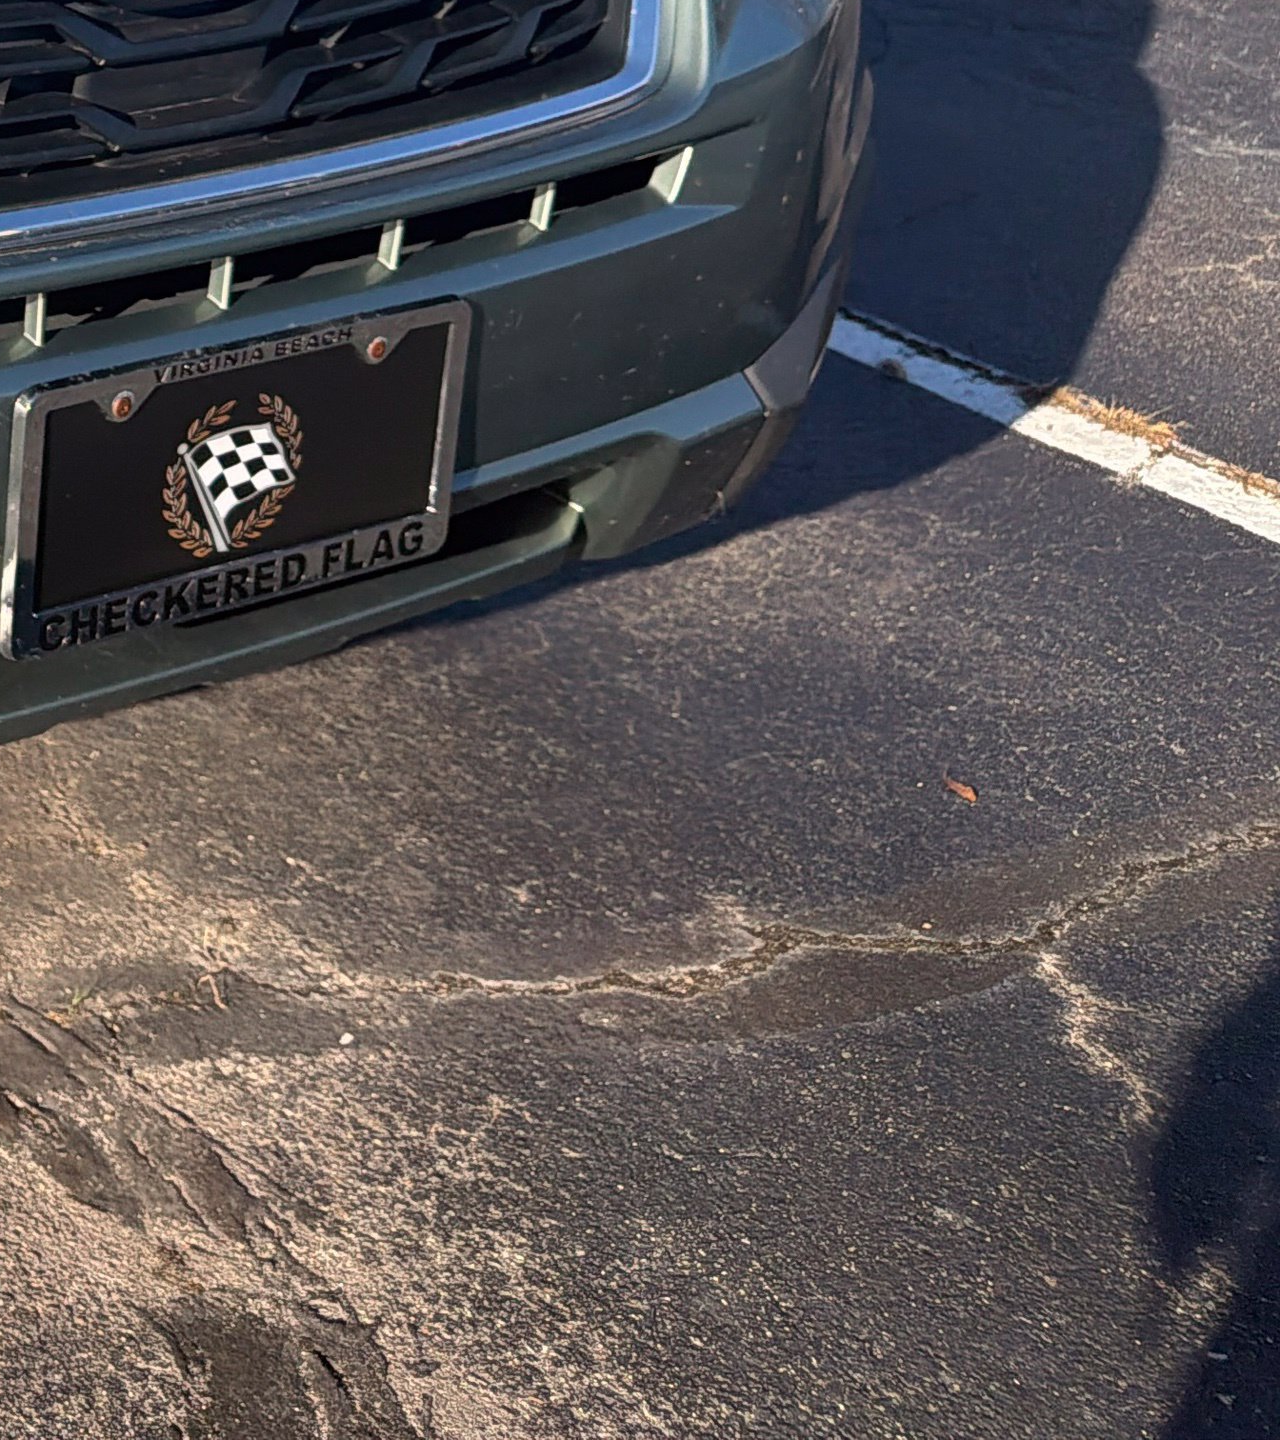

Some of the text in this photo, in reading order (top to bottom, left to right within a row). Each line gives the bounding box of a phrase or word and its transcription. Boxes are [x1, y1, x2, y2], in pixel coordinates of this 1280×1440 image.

[153, 327, 352, 383] VIRGINIA BEACH
[40, 521, 424, 652] CHECKERED FLAG
